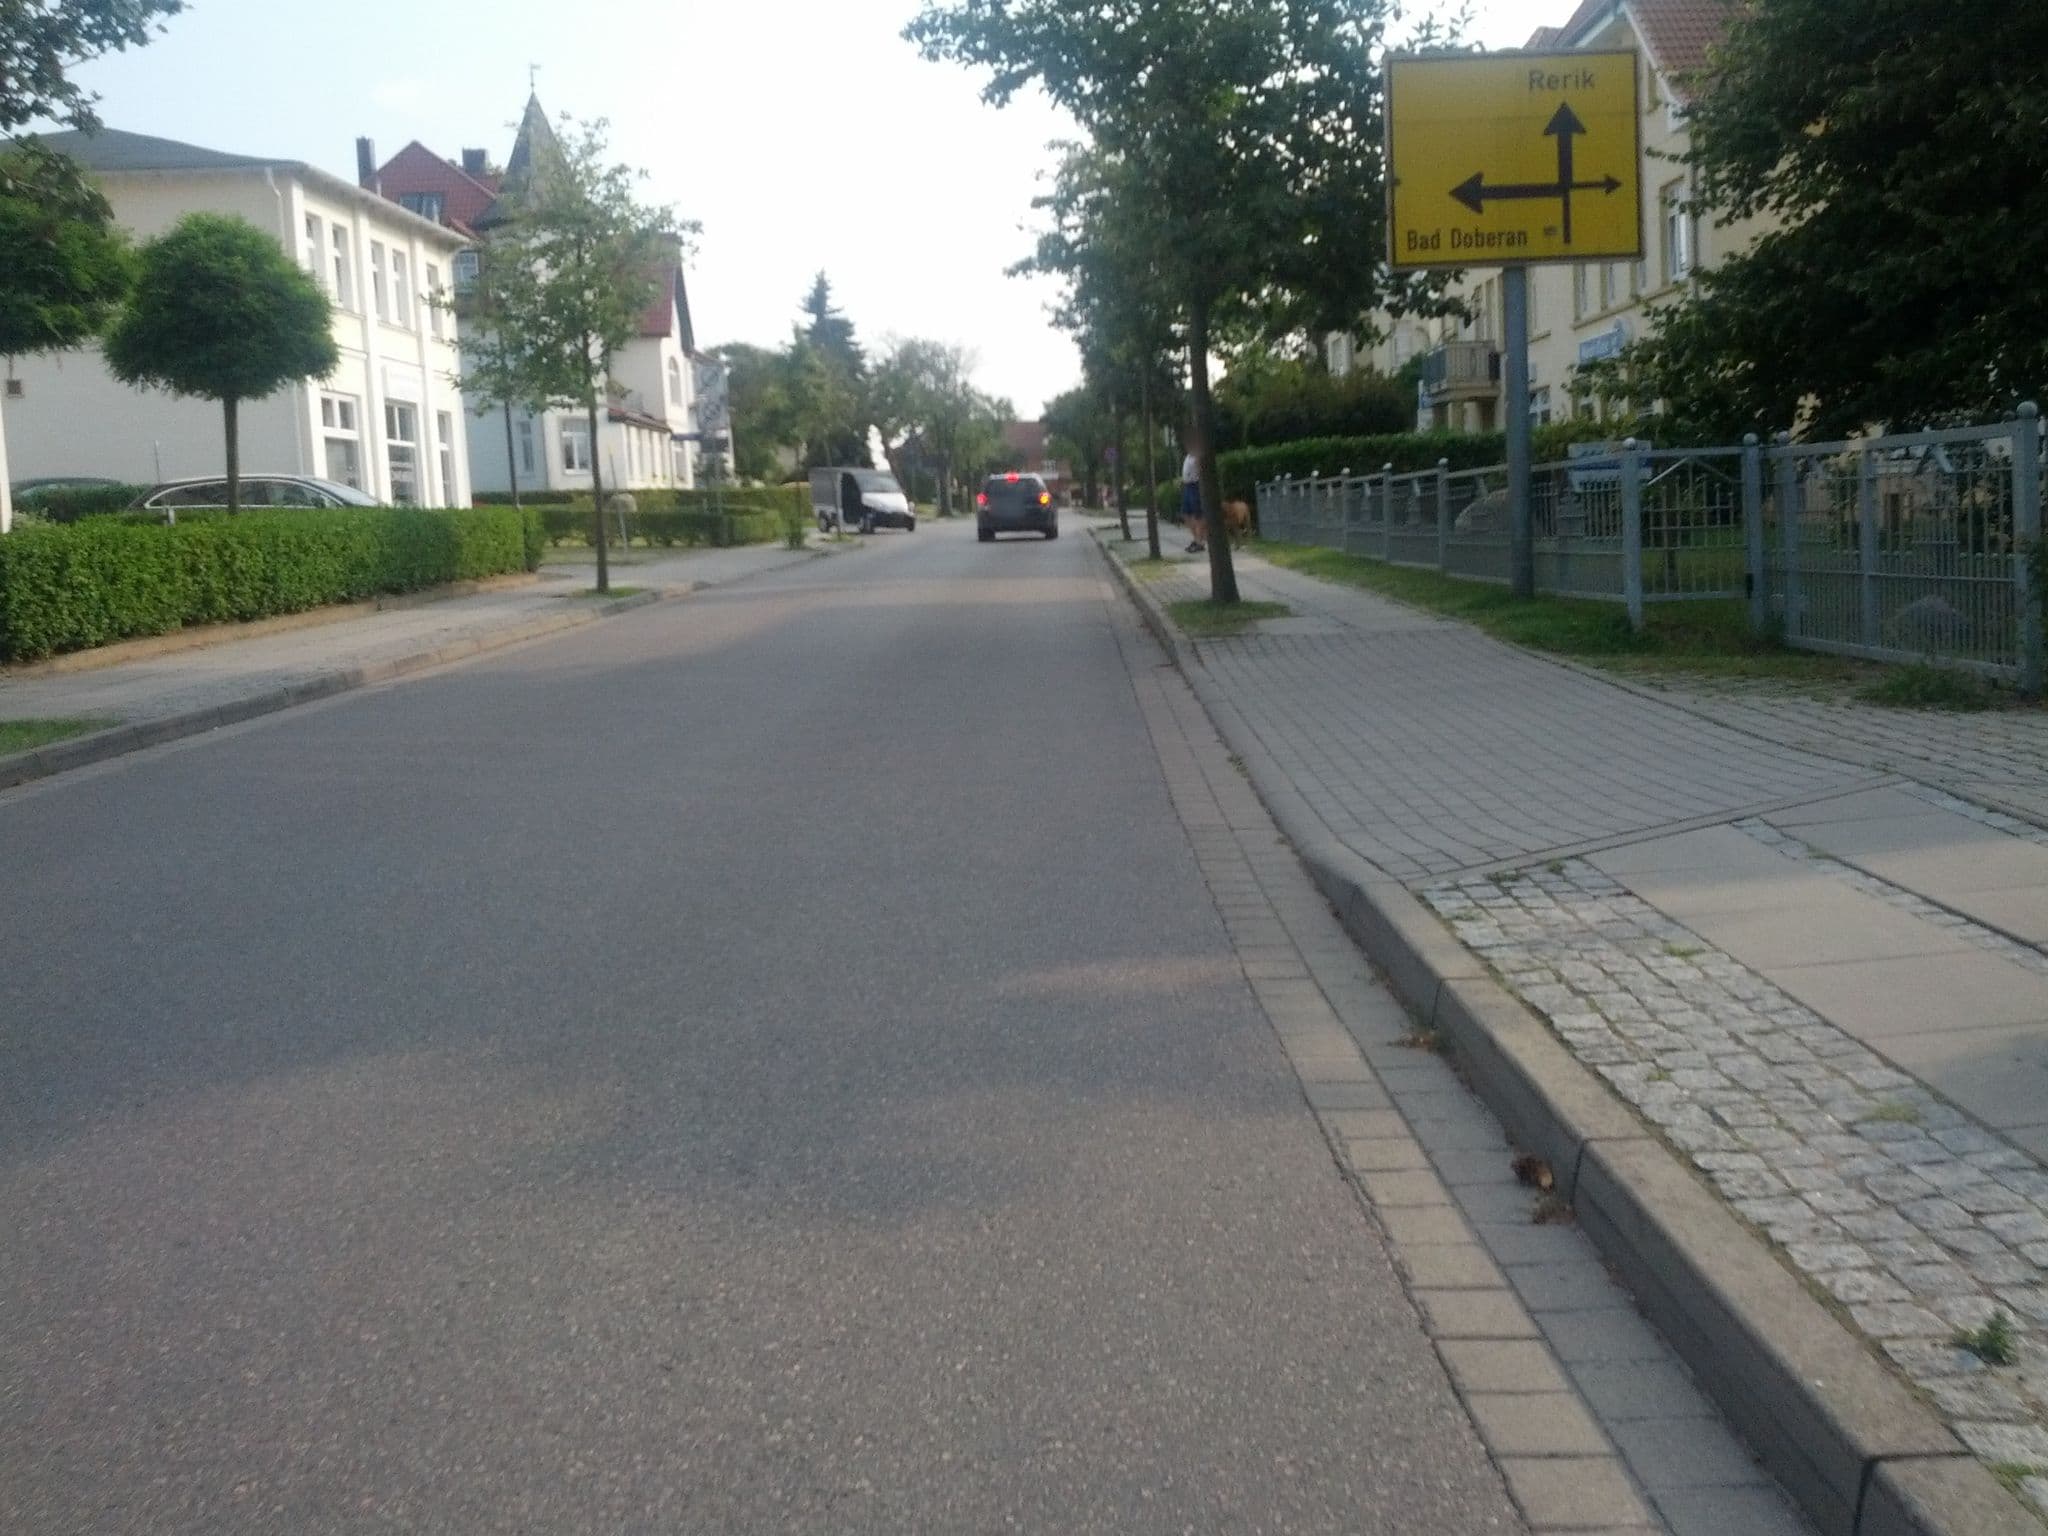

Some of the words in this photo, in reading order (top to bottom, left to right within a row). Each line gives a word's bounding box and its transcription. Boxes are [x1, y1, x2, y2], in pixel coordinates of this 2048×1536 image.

[1529, 68, 1595, 91] Rerik
[1407, 229, 1440, 250] Bad
[1451, 228, 1528, 249] Doberan
